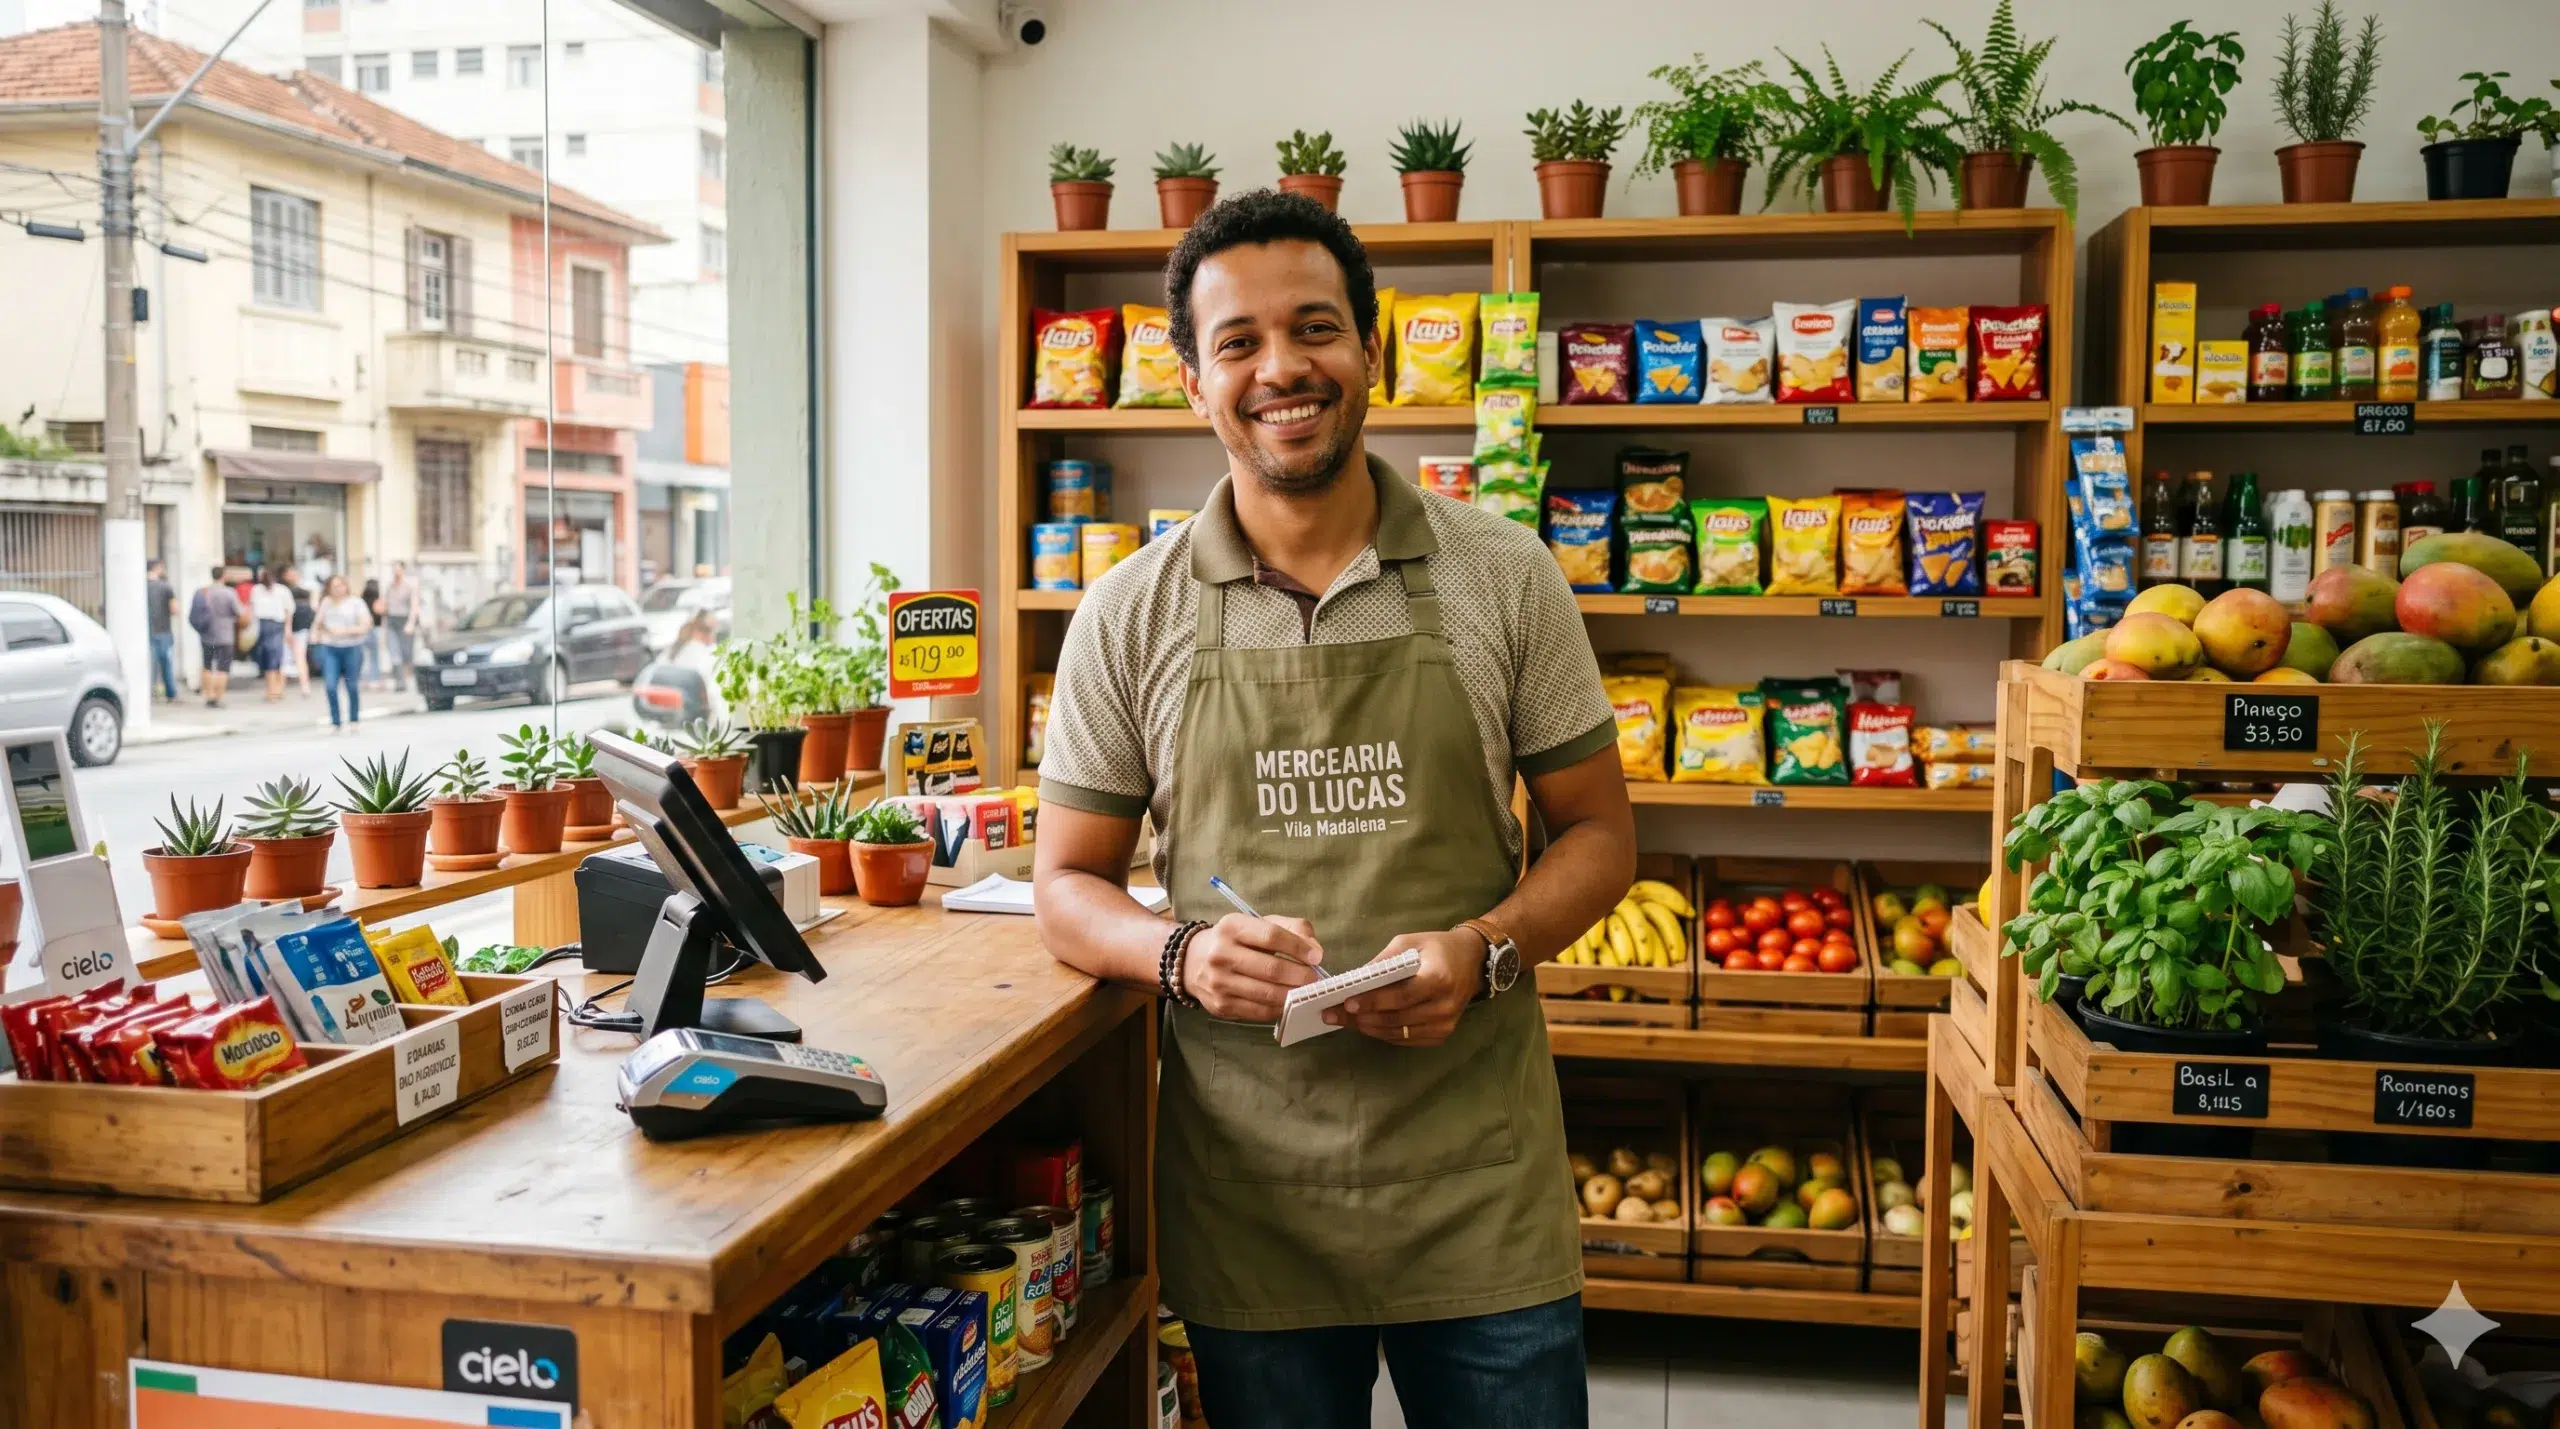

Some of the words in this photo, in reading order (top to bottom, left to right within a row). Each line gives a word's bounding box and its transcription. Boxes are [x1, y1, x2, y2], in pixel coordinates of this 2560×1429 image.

[896, 607, 974, 632] OFERTAS
[1255, 741, 1403, 779] MERCEARIA
[1257, 782, 1298, 817] DO
[1308, 774, 1406, 814] LUCAS
[1284, 821, 1312, 838] Vila
[1316, 817, 1386, 837] Madalena
[61, 950, 114, 980] cielo
[458, 1346, 560, 1390] cielo
